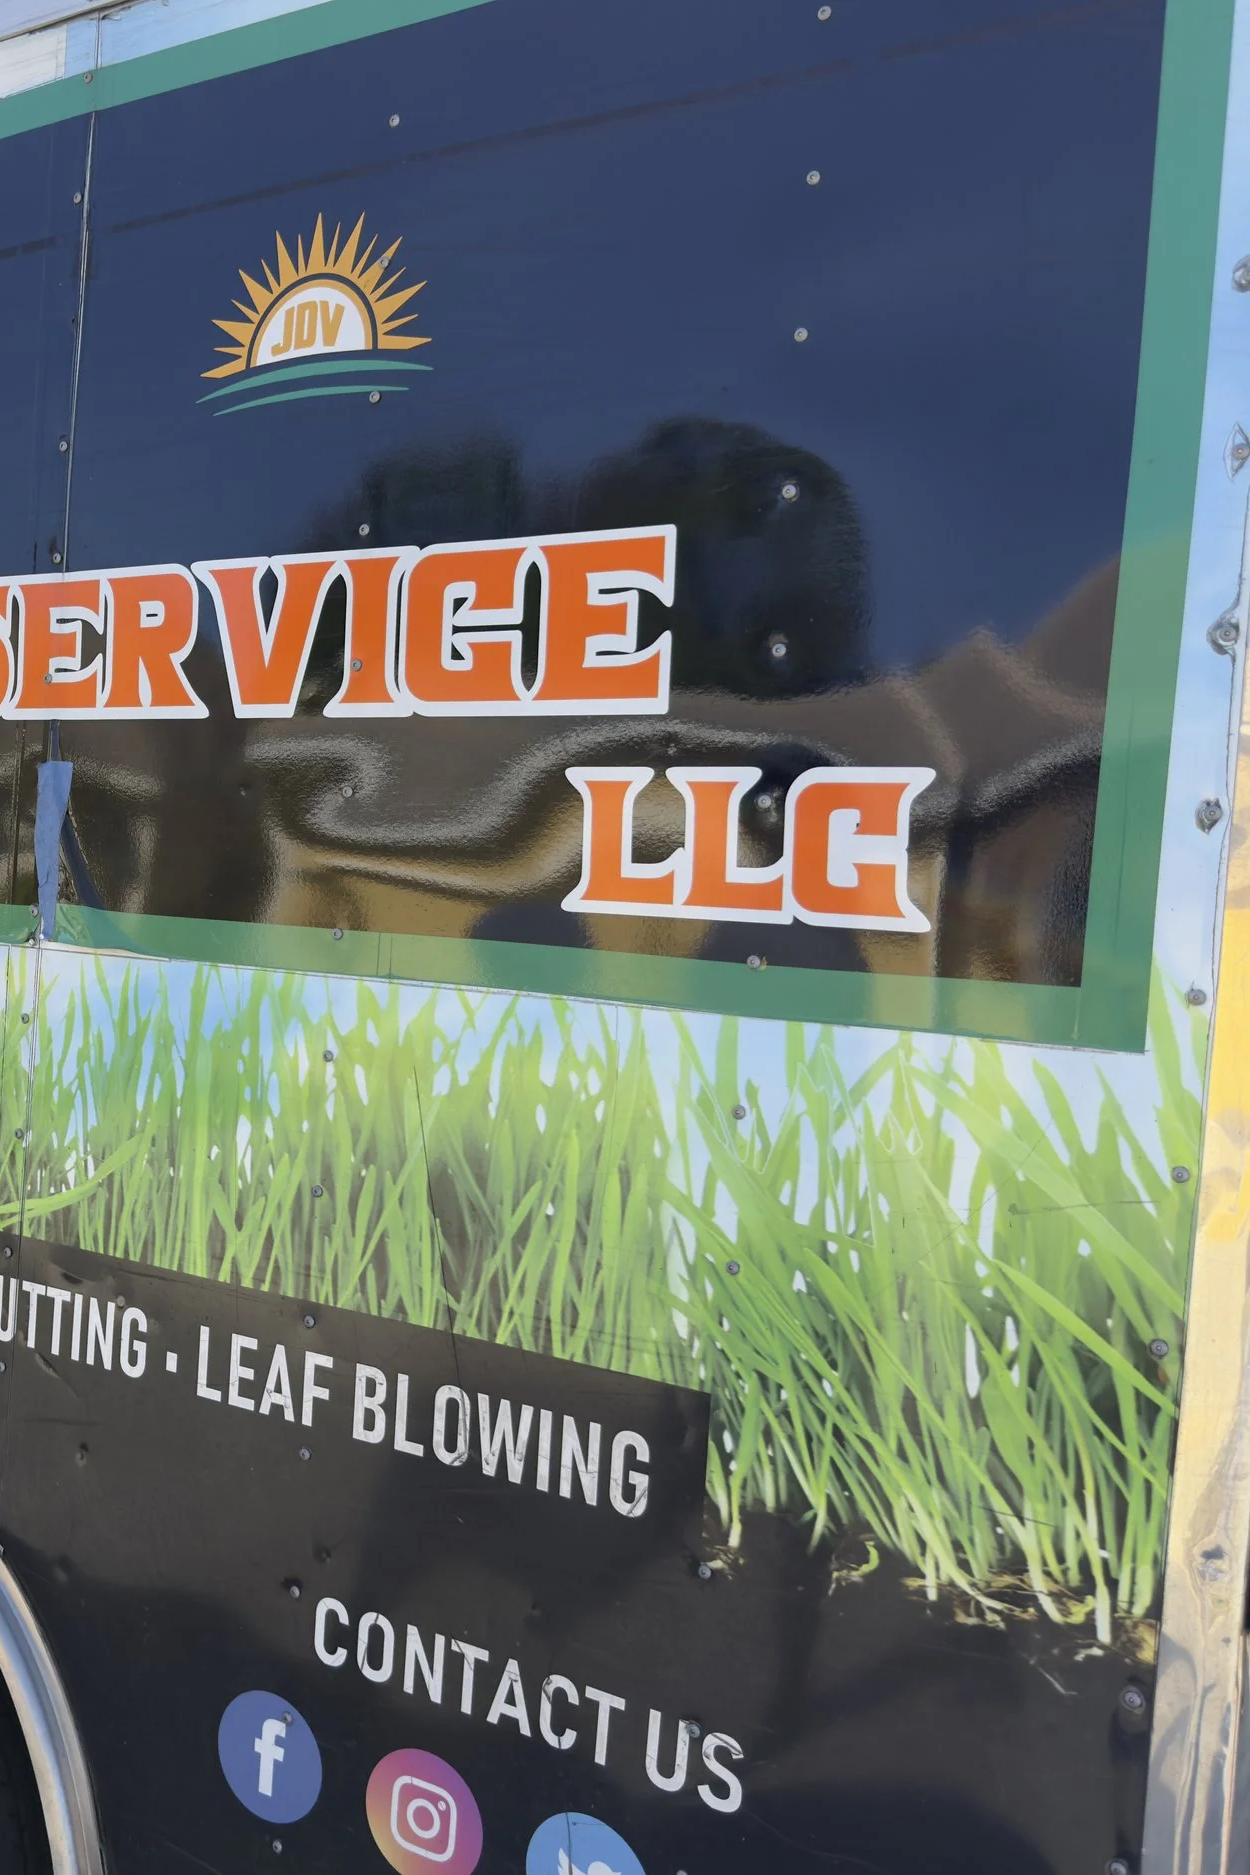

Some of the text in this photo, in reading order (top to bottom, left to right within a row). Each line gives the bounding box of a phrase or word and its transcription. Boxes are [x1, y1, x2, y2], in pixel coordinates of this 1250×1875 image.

[271, 300, 345, 357] JDV
[560, 765, 937, 934] LLC
[196, 1324, 334, 1427] LEAF
[352, 1363, 651, 1519] BLOWING
[313, 1597, 744, 1813] CONTACT US
